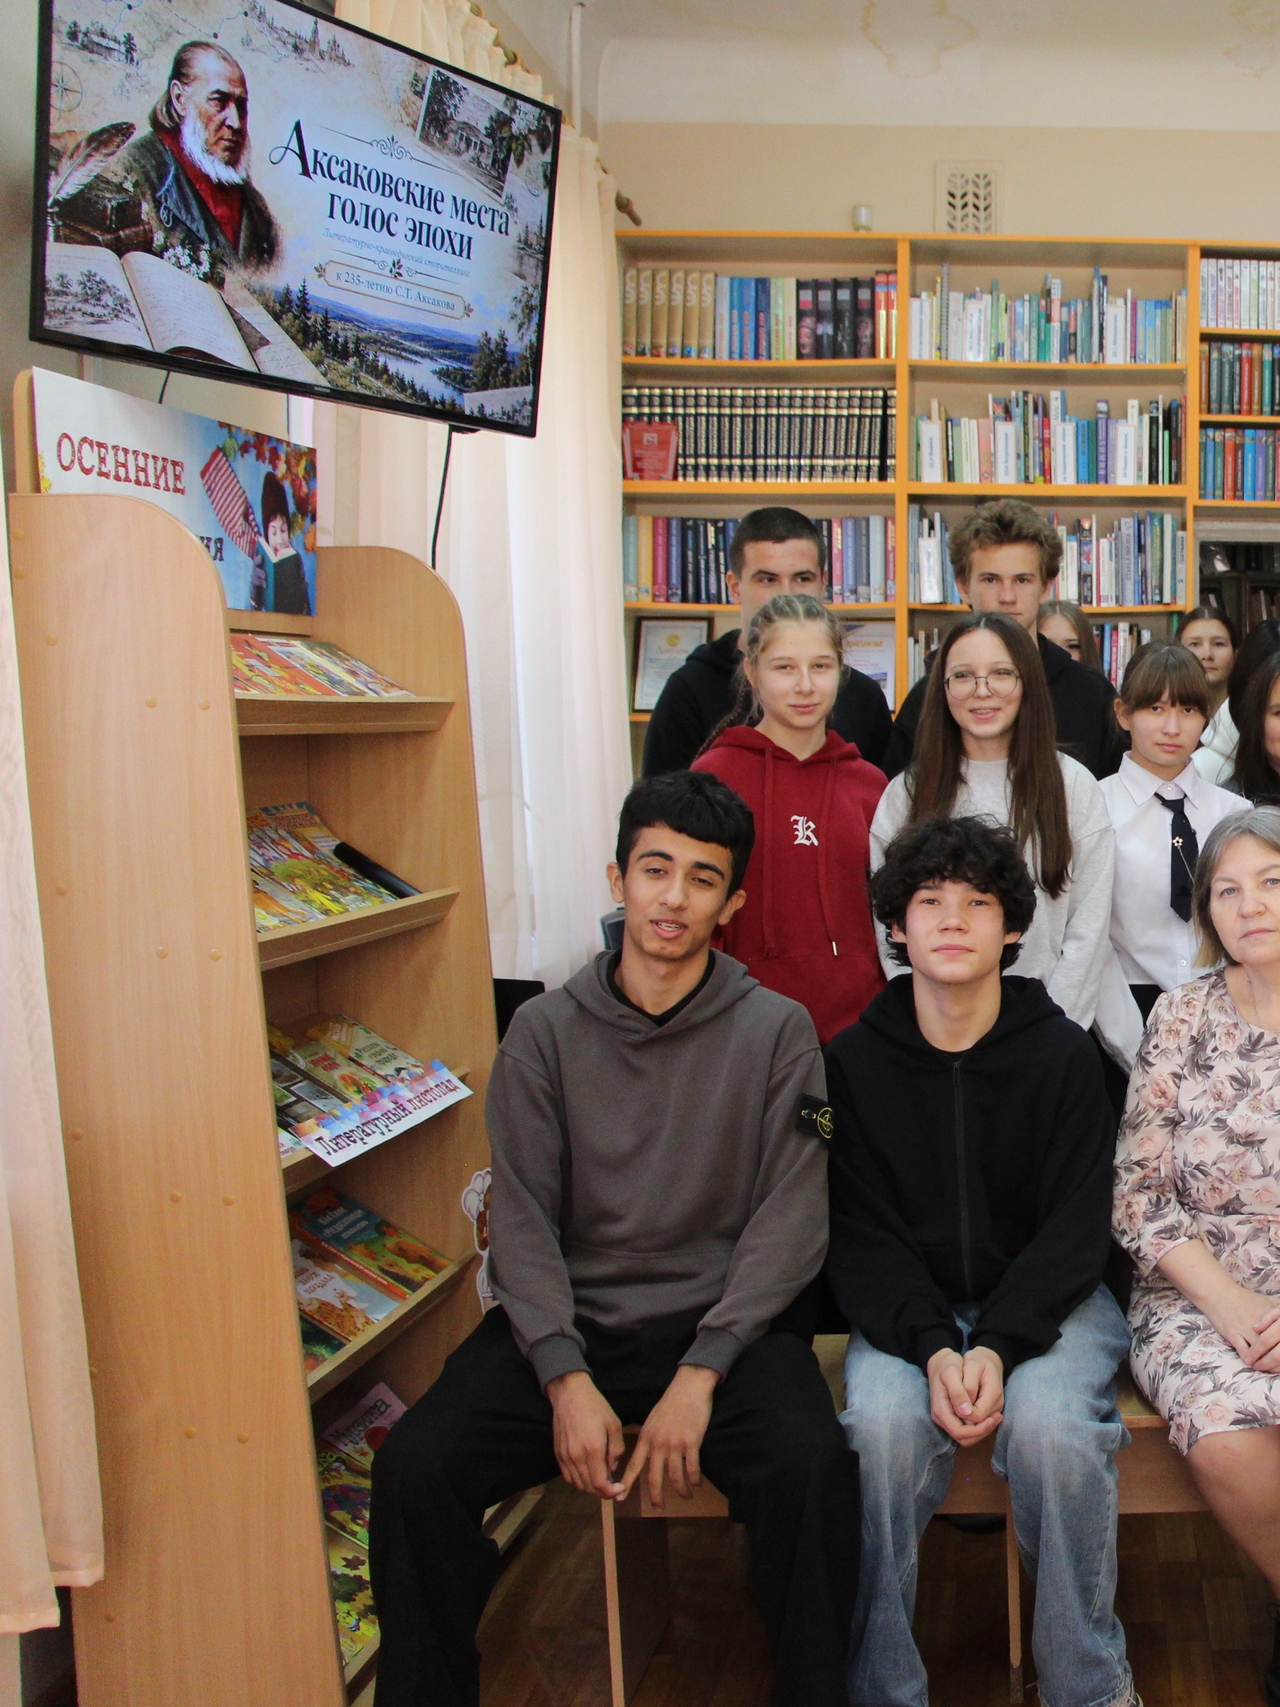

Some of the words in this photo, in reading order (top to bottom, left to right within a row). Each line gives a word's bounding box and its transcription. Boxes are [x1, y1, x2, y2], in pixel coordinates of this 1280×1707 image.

[269, 118, 445, 215] Аксаковские
[450, 194, 510, 236] места
[344, 271, 393, 294] 235-летию
[414, 291, 456, 311] Аксакова
[57, 432, 186, 496] ОСЕННИЕ
[314, 1099, 413, 1156] Литературный
[408, 1078, 462, 1112] листопад
